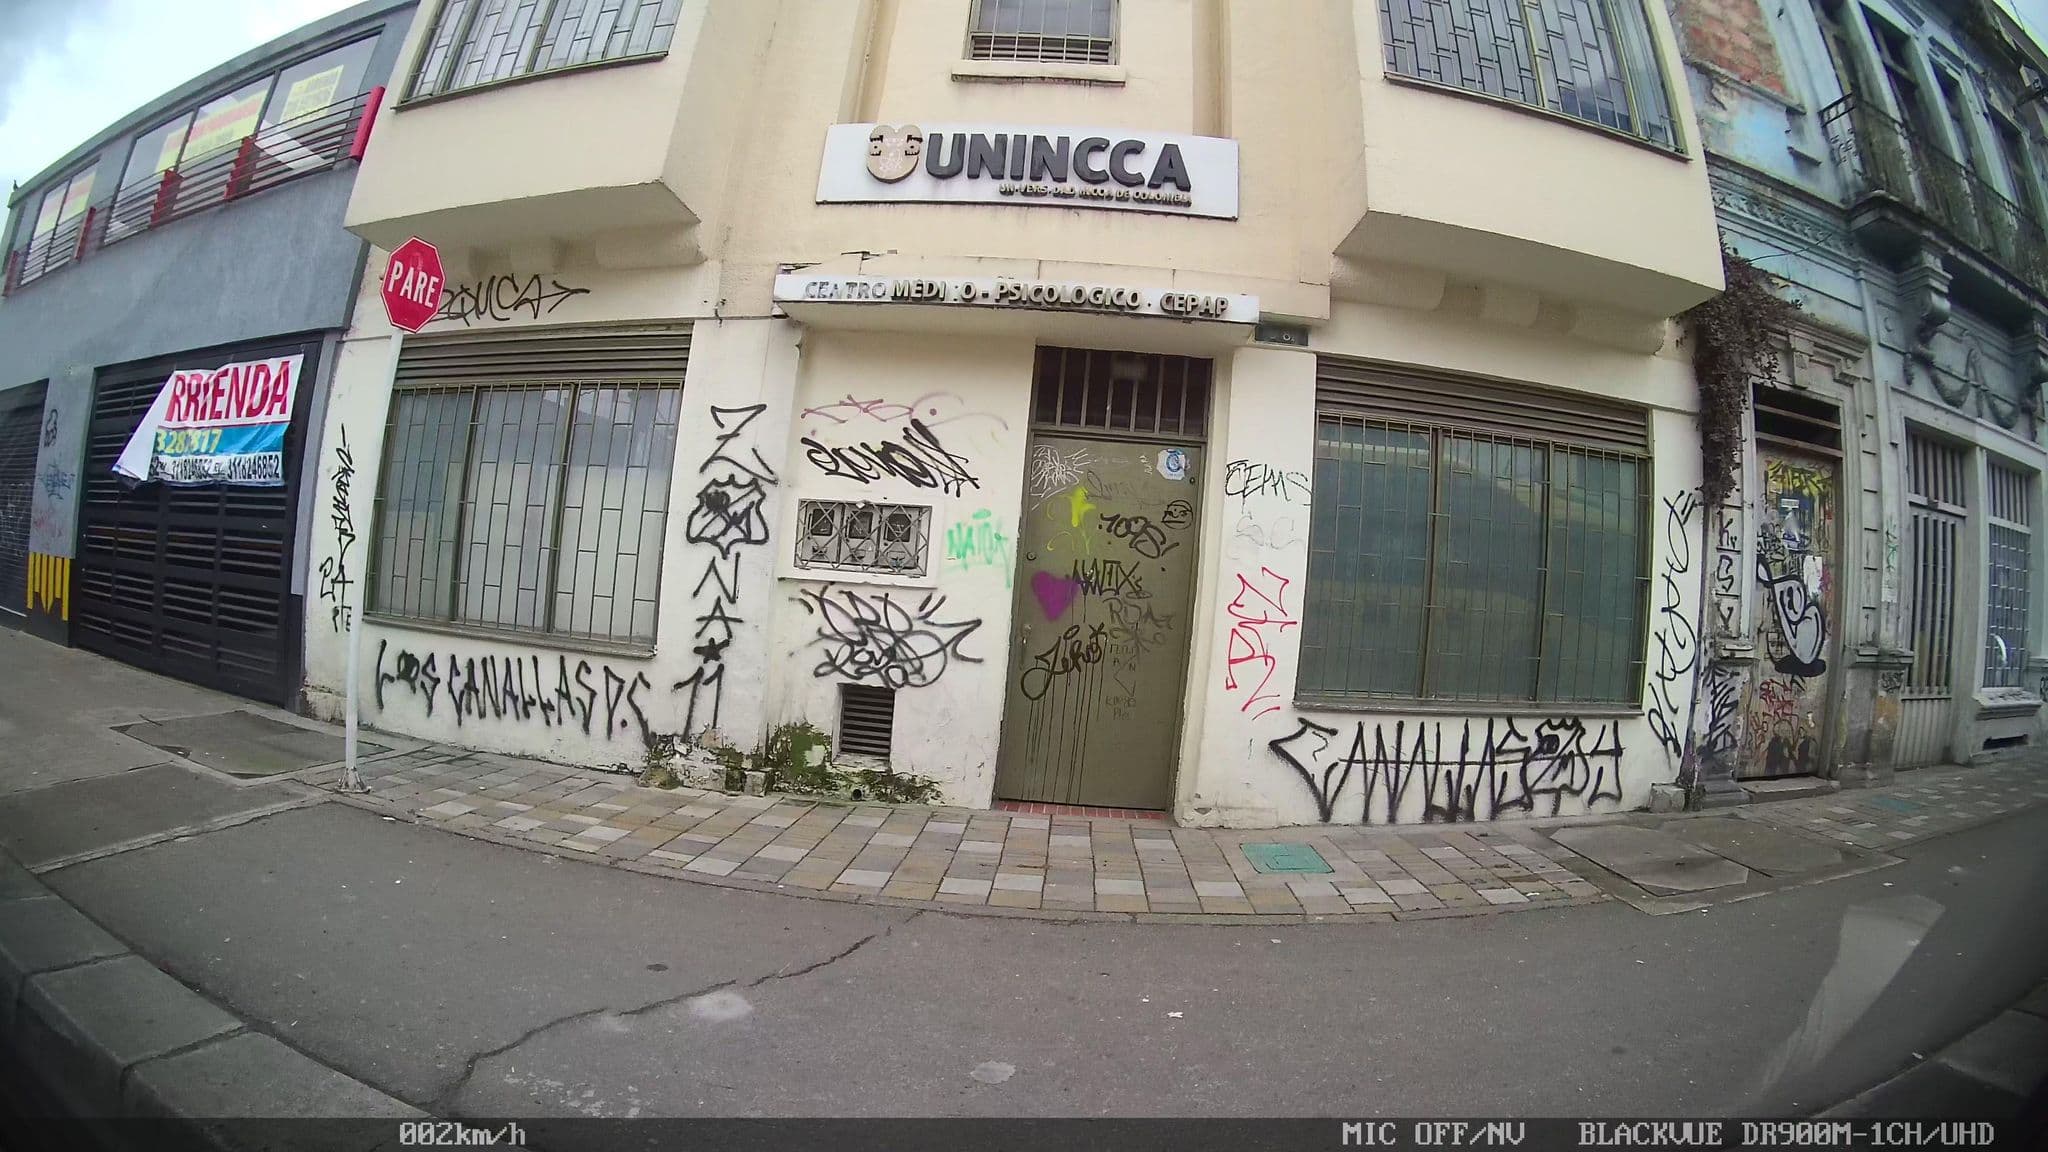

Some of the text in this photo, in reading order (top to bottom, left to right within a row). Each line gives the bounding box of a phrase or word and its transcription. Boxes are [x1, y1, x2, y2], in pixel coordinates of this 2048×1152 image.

[924, 132, 1192, 192] UNINCCA
[387, 260, 440, 309] PARE
[994, 281, 1143, 308] PSICOLOGICO
[1160, 292, 1230, 317] CEPAP
